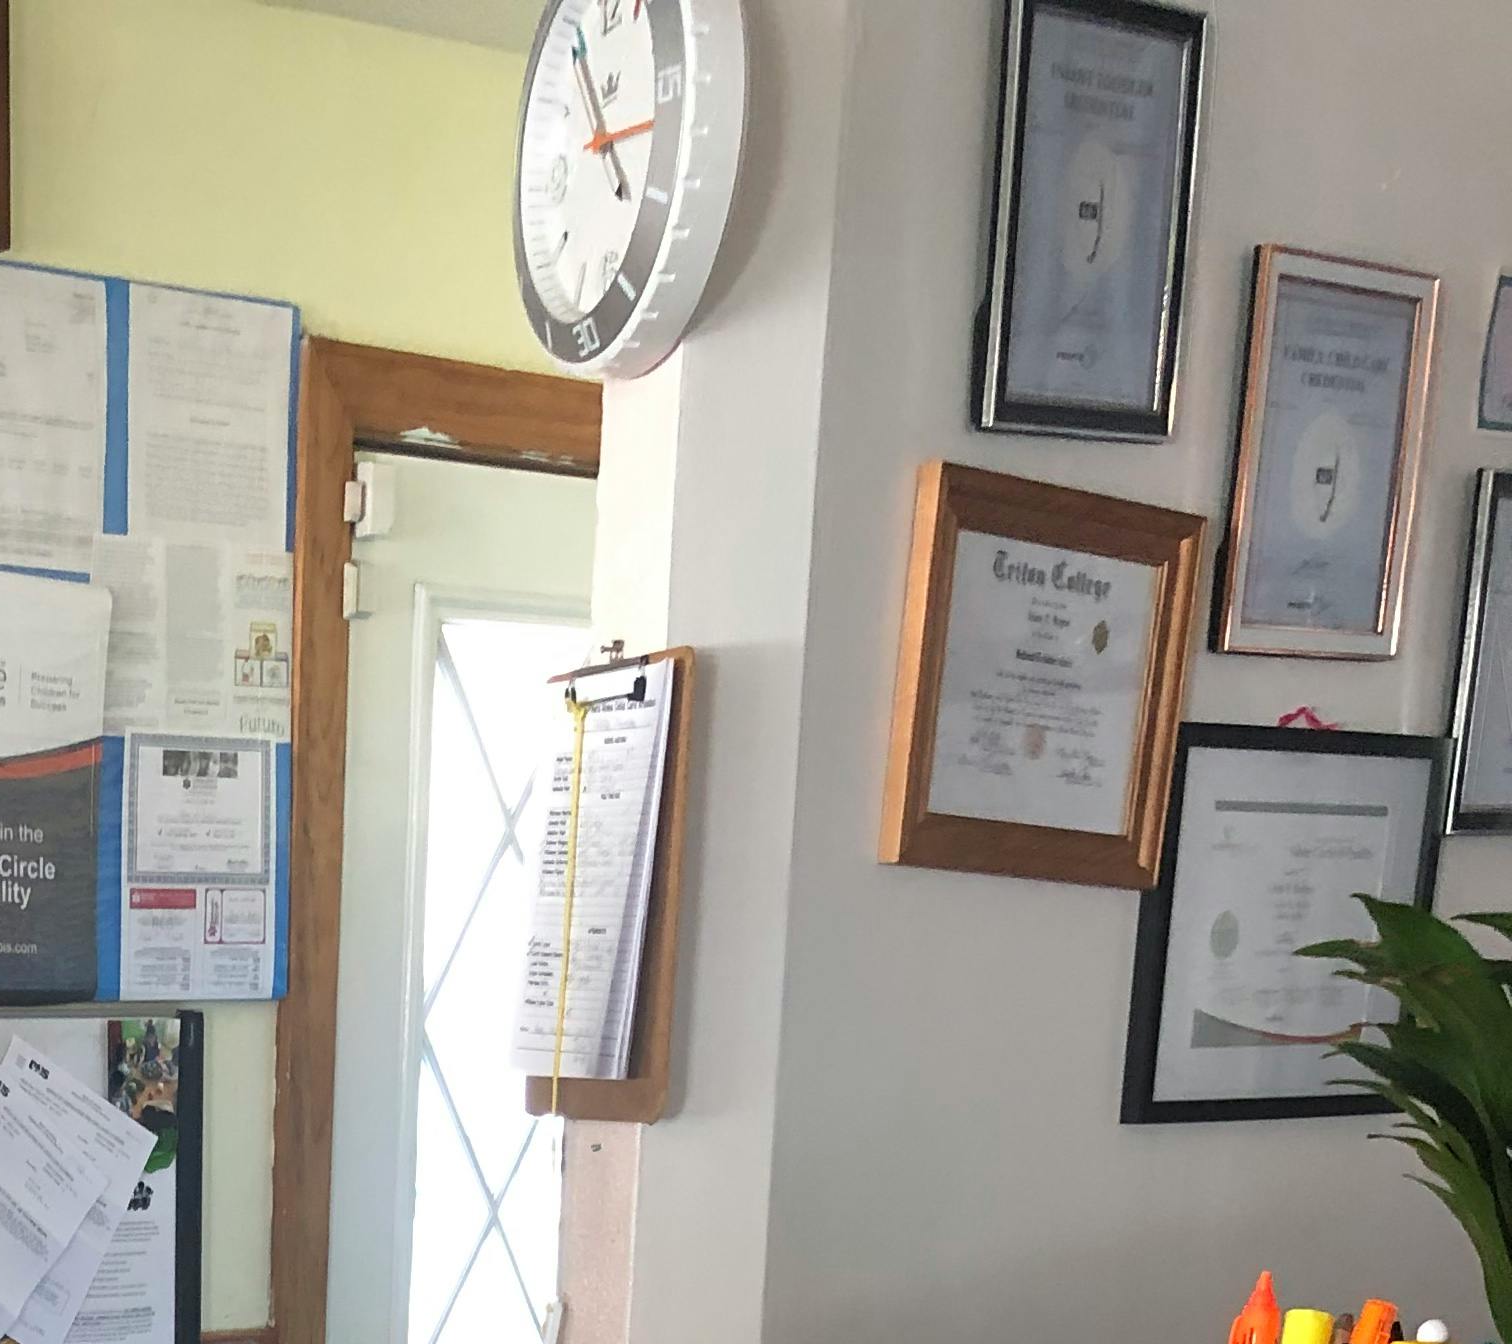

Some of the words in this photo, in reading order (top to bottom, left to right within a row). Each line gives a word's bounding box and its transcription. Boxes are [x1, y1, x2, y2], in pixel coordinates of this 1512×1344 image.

[1051, 560, 1112, 603] College
[0, 822, 14, 842] in
[19, 824, 44, 844] the
